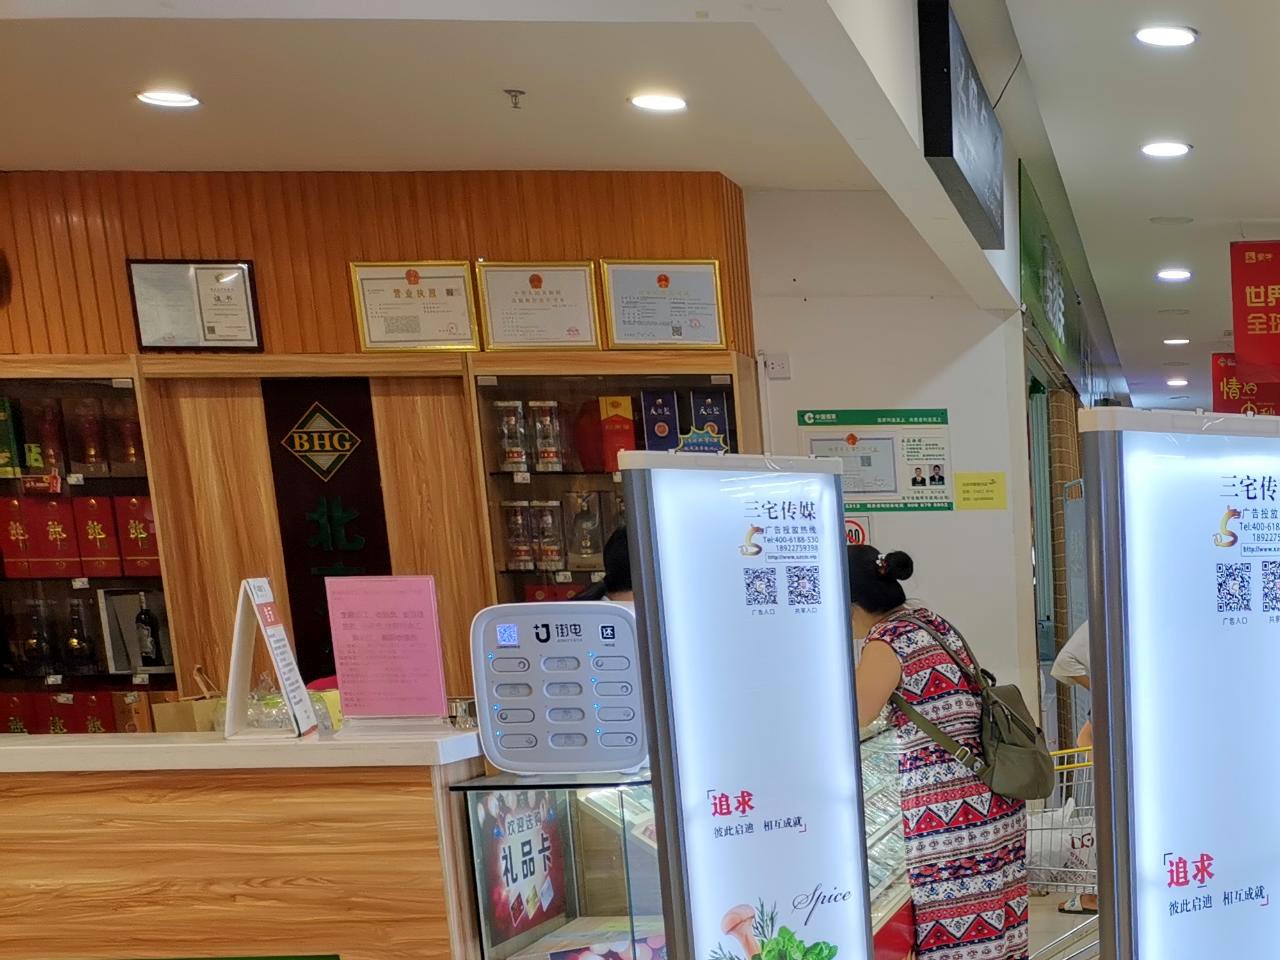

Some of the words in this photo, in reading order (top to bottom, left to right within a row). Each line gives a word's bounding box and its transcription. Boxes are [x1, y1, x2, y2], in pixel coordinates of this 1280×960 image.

[293, 432, 351, 451] BHG
[743, 500, 817, 521] 三宅传媒
[501, 832, 552, 888] 礼品卡
[792, 882, 852, 926] Spice
[1169, 895, 1213, 916] 彼此启迪
